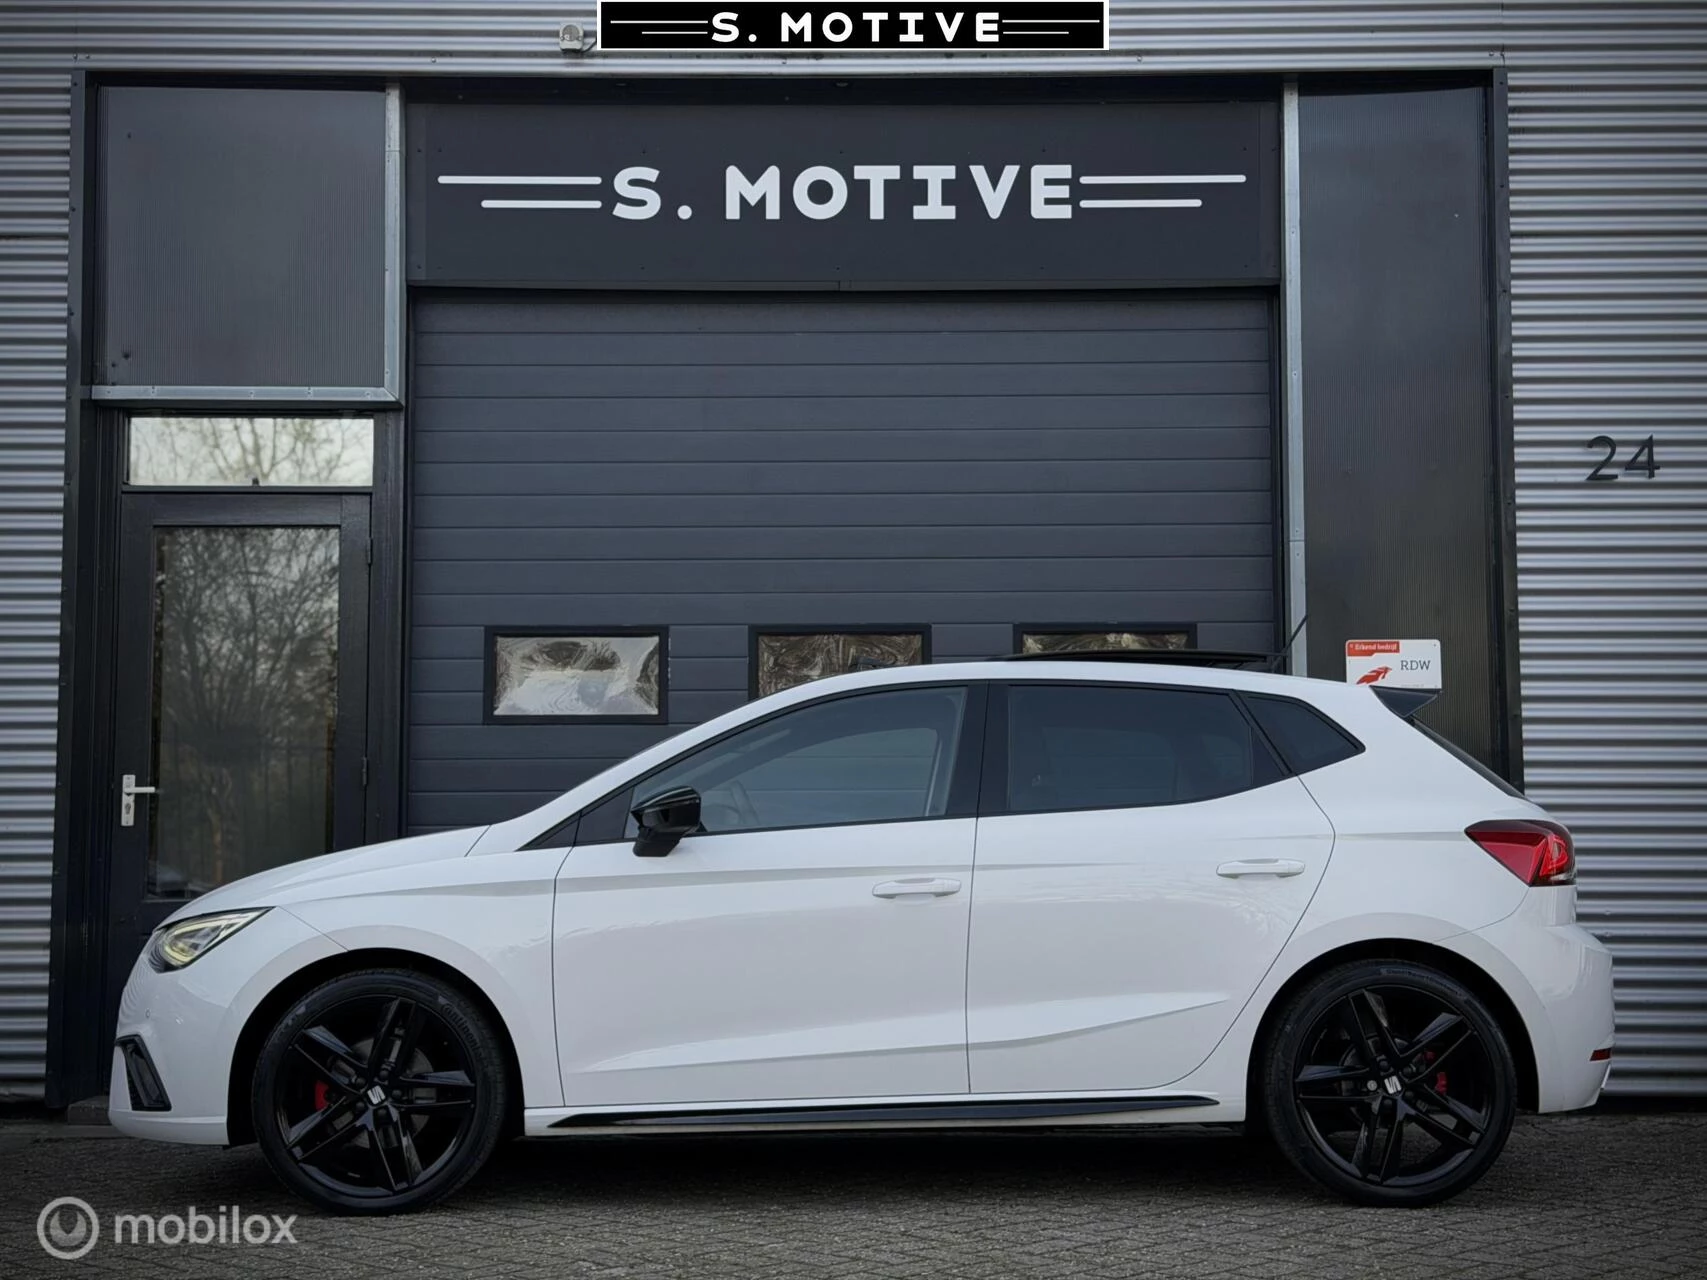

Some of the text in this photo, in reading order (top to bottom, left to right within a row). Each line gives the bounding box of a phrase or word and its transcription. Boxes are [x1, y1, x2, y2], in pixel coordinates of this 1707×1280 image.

[612, 164, 1073, 220] S. MOTIVE
[1585, 433, 1660, 480] 24
[1400, 660, 1431, 671] RDW
